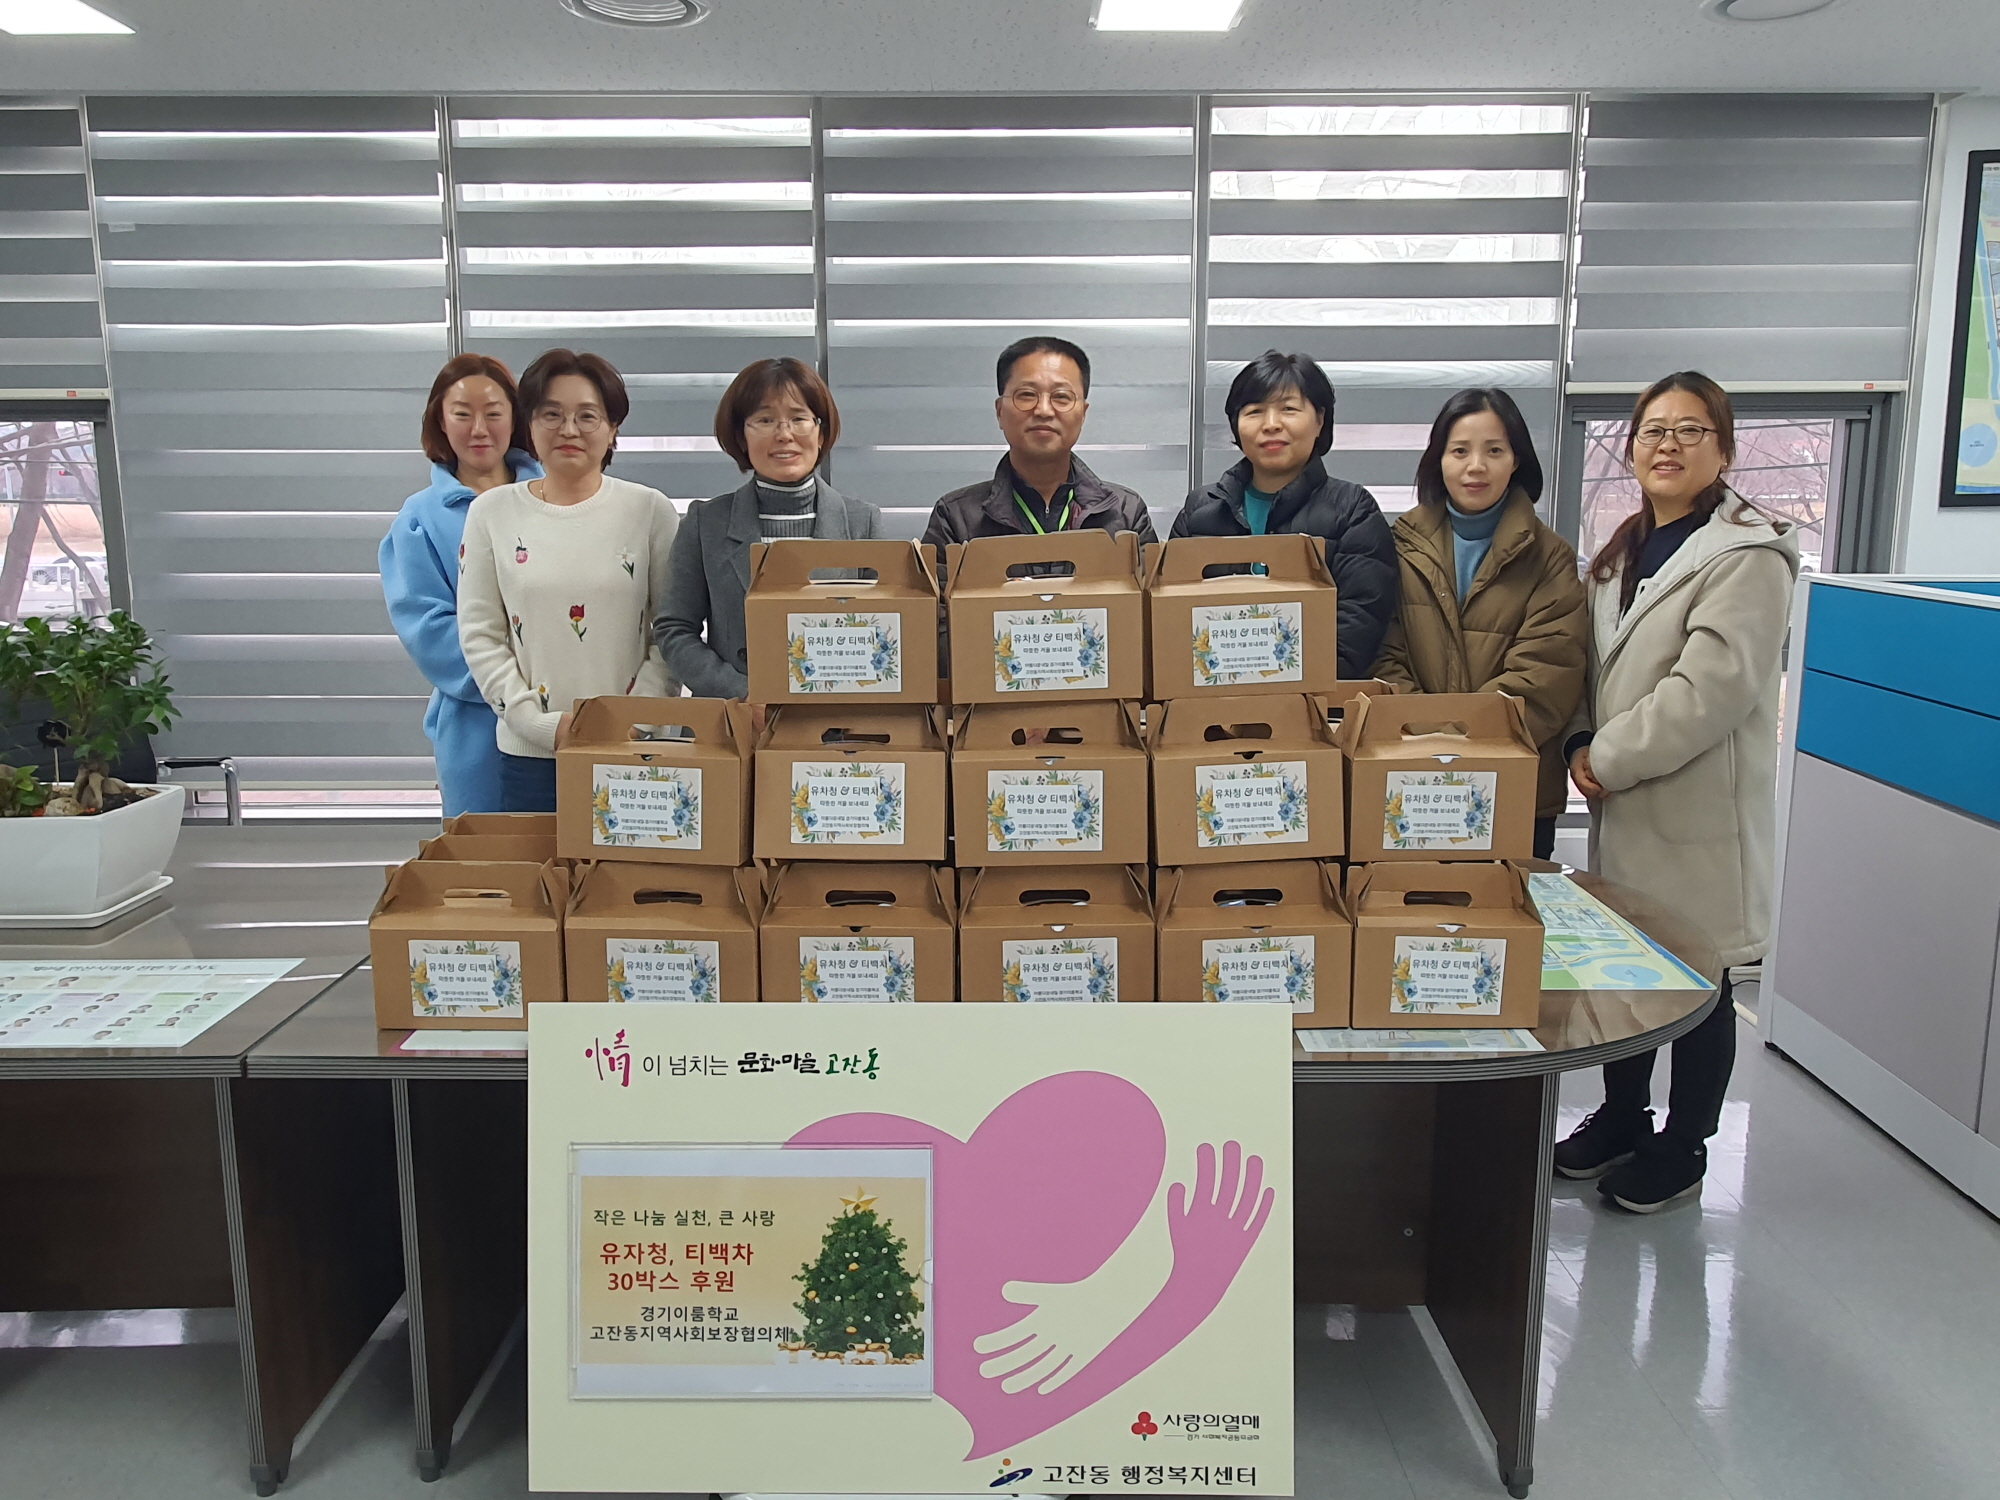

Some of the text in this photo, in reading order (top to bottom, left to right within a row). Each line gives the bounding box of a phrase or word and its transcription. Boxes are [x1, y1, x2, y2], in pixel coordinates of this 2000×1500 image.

[1043, 632, 1053, 642] &
[1239, 627, 1249, 637] &
[836, 635, 846, 645] &
[639, 789, 648, 798] &
[840, 785, 849, 795] &
[1244, 787, 1253, 796] &
[1037, 793, 1047, 803] &
[1432, 793, 1442, 803] &
[457, 962, 467, 971] &
[655, 961, 665, 970] &
[848, 959, 858, 968] &
[1052, 962, 1062, 971] &
[1250, 960, 1260, 969] &
[1441, 959, 1451, 968] &
[643, 1055, 661, 1076] 이
[669, 1055, 729, 1076] 넘치는
[825, 1048, 880, 1080] 고잔동
[593, 1209, 776, 1227] 작은 나눔 실천, 큰 사랑
[600, 1242, 754, 1266] 유자청, 티백차
[607, 1270, 734, 1292] 30박스 후원
[640, 1306, 739, 1322] 경기이룸학교
[590, 1326, 790, 1342] 고잔동지역사회보장협의체
[1163, 1414, 1260, 1432] 사랑의열매
[1042, 1465, 1257, 1486] 고잔동 행정복지센터
